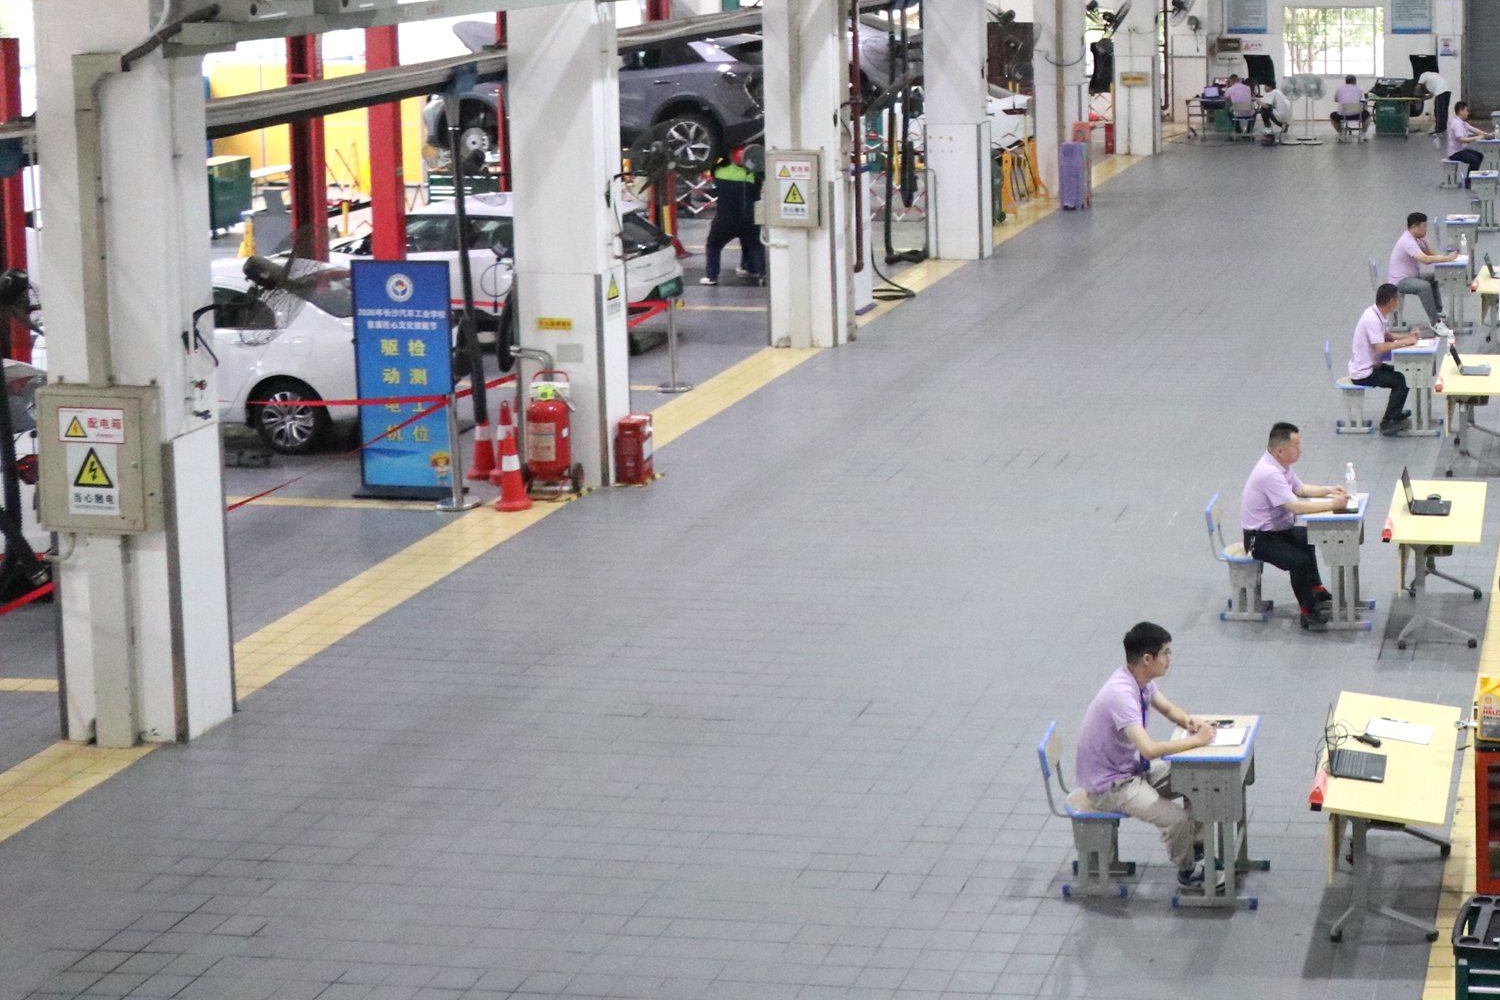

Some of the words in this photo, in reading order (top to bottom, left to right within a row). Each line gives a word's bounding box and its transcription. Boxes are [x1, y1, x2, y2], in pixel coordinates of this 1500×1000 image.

[88, 417, 122, 430] 配电箱
[74, 492, 115, 505] 当心触电
